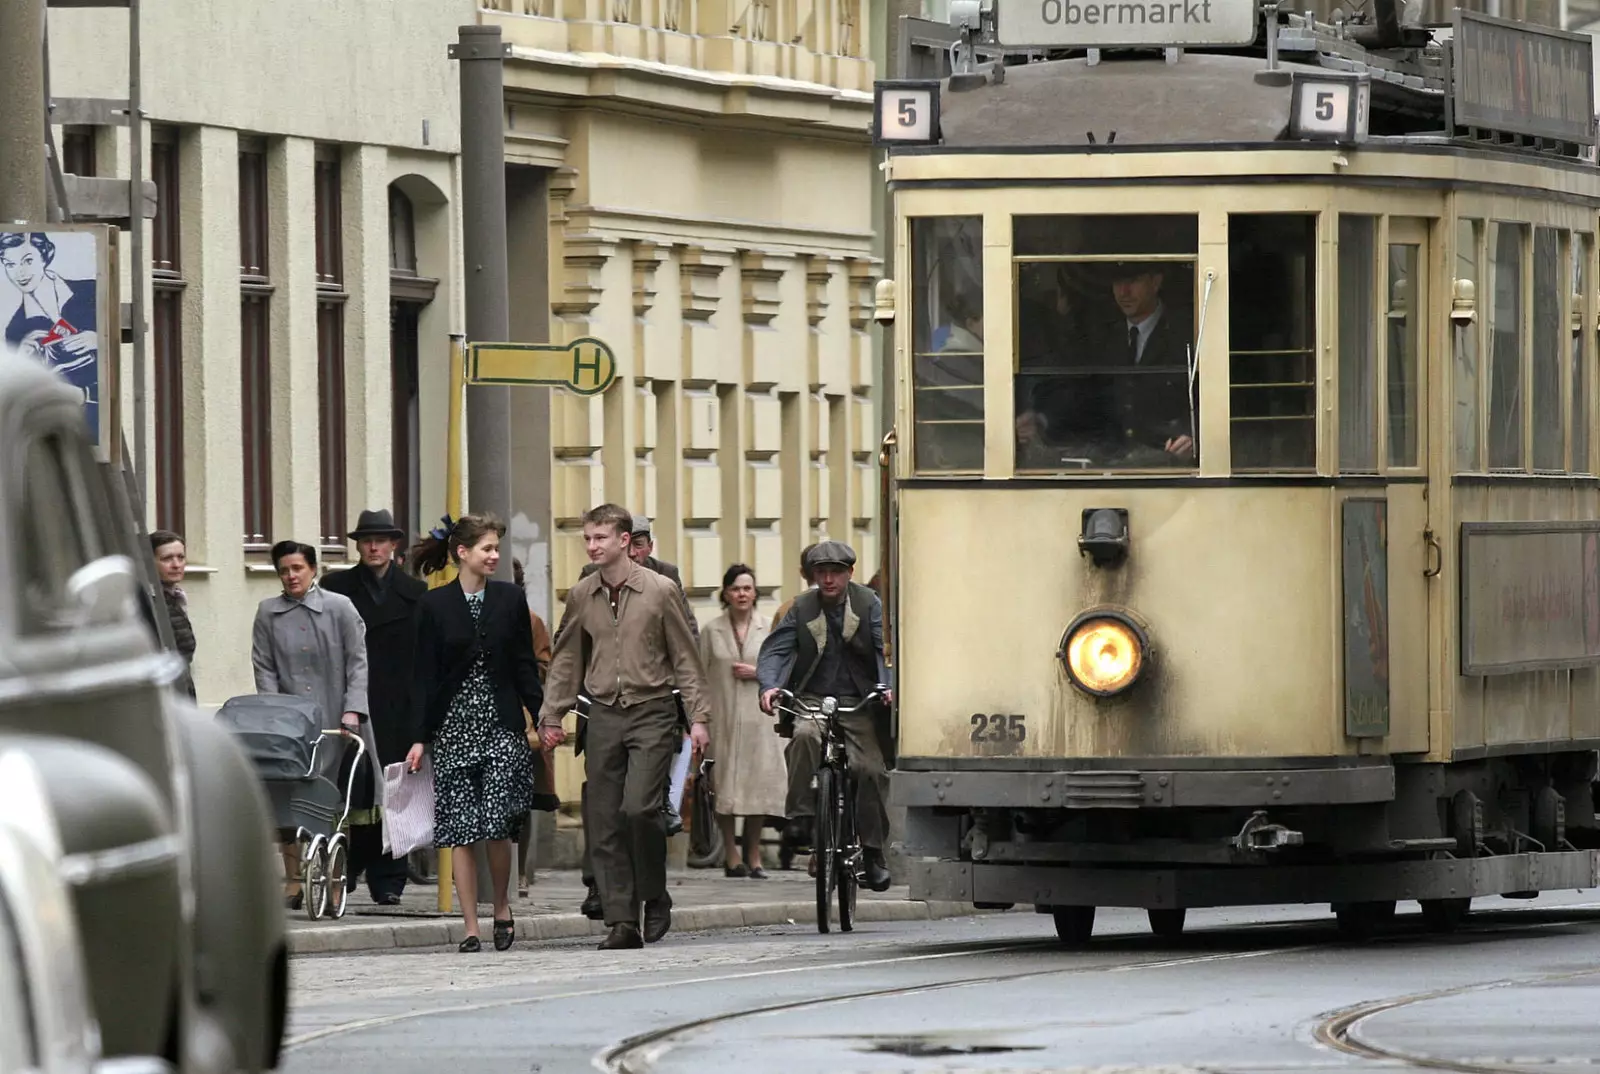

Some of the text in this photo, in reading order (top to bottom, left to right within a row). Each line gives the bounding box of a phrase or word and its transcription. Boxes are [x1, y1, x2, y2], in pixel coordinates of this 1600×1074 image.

[1041, 0, 1213, 24] Obermarkt
[898, 98, 917, 127] 5
[1315, 92, 1334, 121] 5
[573, 348, 601, 385] H
[970, 713, 1026, 742] 235
